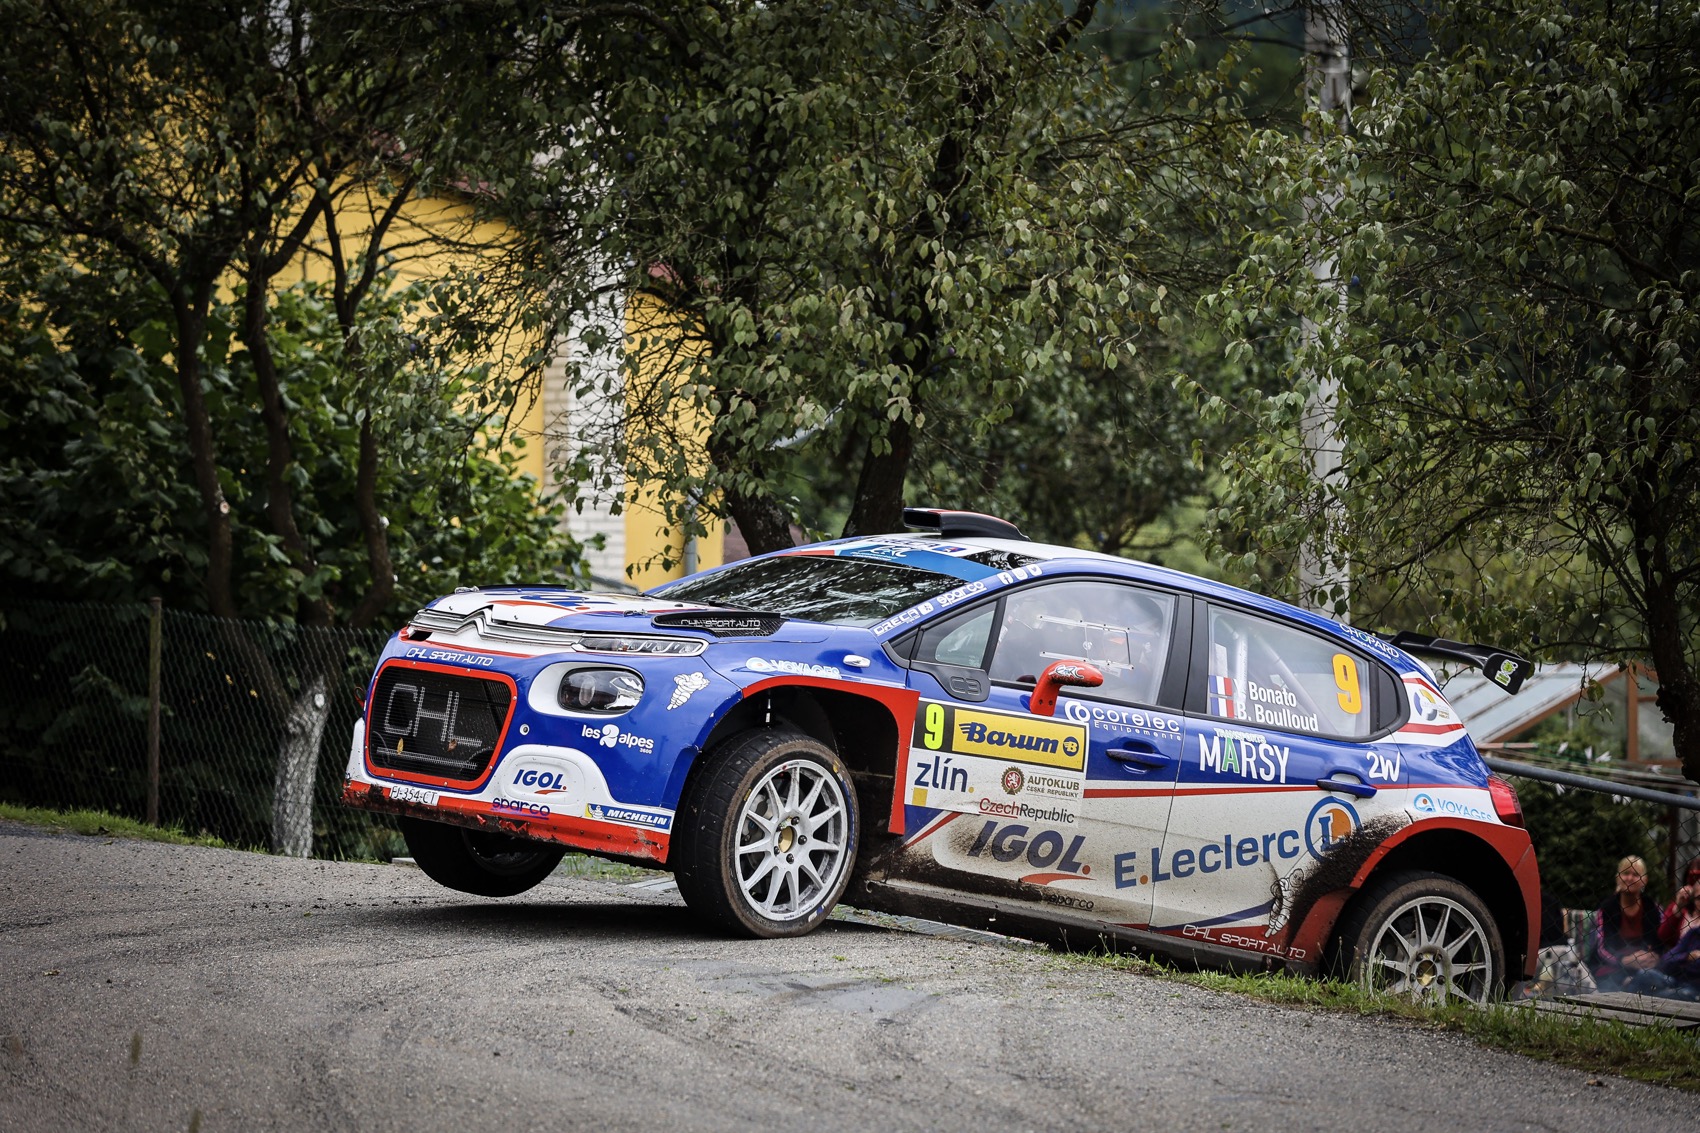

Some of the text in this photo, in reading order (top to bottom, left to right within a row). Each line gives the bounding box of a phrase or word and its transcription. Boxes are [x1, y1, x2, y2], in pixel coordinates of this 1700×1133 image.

[936, 581, 987, 607] sparco
[735, 619, 760, 627] AUTO
[406, 647, 494, 666] CHL SPORT AUTO
[950, 675, 982, 696] C3
[1248, 681, 1297, 708] Bonato
[1331, 653, 1363, 715] 9
[384, 683, 483, 747] CHL
[1092, 707, 1180, 732] corelec
[1237, 702, 1320, 732] B. Boulloud
[581, 724, 655, 749] les 2 alpes
[923, 703, 1059, 754] 9 Barum
[1198, 733, 1290, 784] MARSY
[1366, 751, 1400, 782] 2W
[1027, 775, 1080, 791] AUTOKLUB
[1046, 788, 1079, 798] REPUBLIKY
[491, 797, 551, 816] sparco
[606, 809, 668, 826] MICHELIN
[979, 797, 1075, 824] CzechRepublic
[1437, 797, 1493, 821] VOYAGES
[1048, 894, 1095, 910] sparco
[1182, 924, 1307, 959] CHL SPORT AUTO
